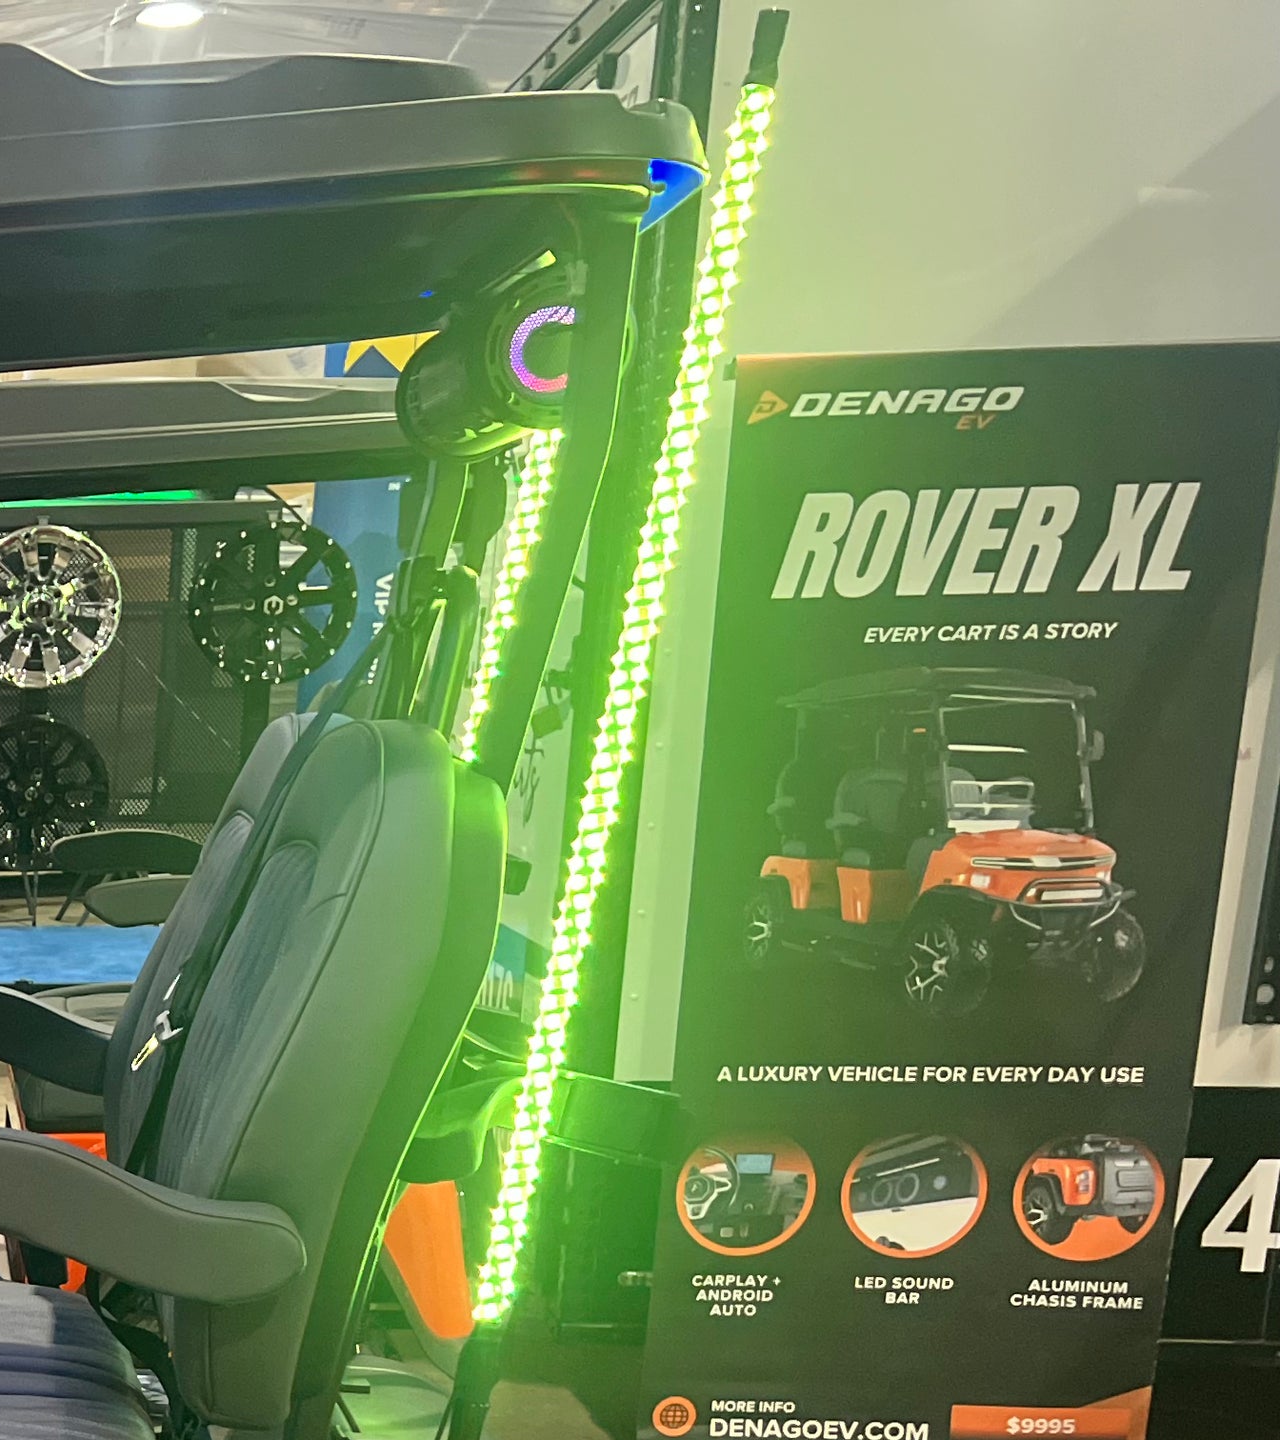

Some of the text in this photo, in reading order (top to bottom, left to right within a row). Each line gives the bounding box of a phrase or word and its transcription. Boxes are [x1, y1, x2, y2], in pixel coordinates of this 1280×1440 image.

[790, 386, 1025, 417] DENAGO
[955, 413, 996, 430] EV
[770, 481, 1201, 600] ROVER XL
[863, 621, 1119, 643] EVERY CART IS A STORY
[716, 1066, 1146, 1084] A LUXURY VEHICLE FOR EVERY DAY USE
[691, 1274, 768, 1287] CARPLAY
[854, 1276, 954, 1290] LED SOUND
[1027, 1279, 1129, 1294] ALUMINUM
[695, 1289, 774, 1302] ANDROID
[884, 1292, 920, 1305] BAR
[1009, 1293, 1144, 1310] CHASIS FRAME
[709, 1304, 757, 1317] AUTO
[711, 1400, 796, 1414] MORE INFO
[1005, 1415, 1076, 1436] $9995
